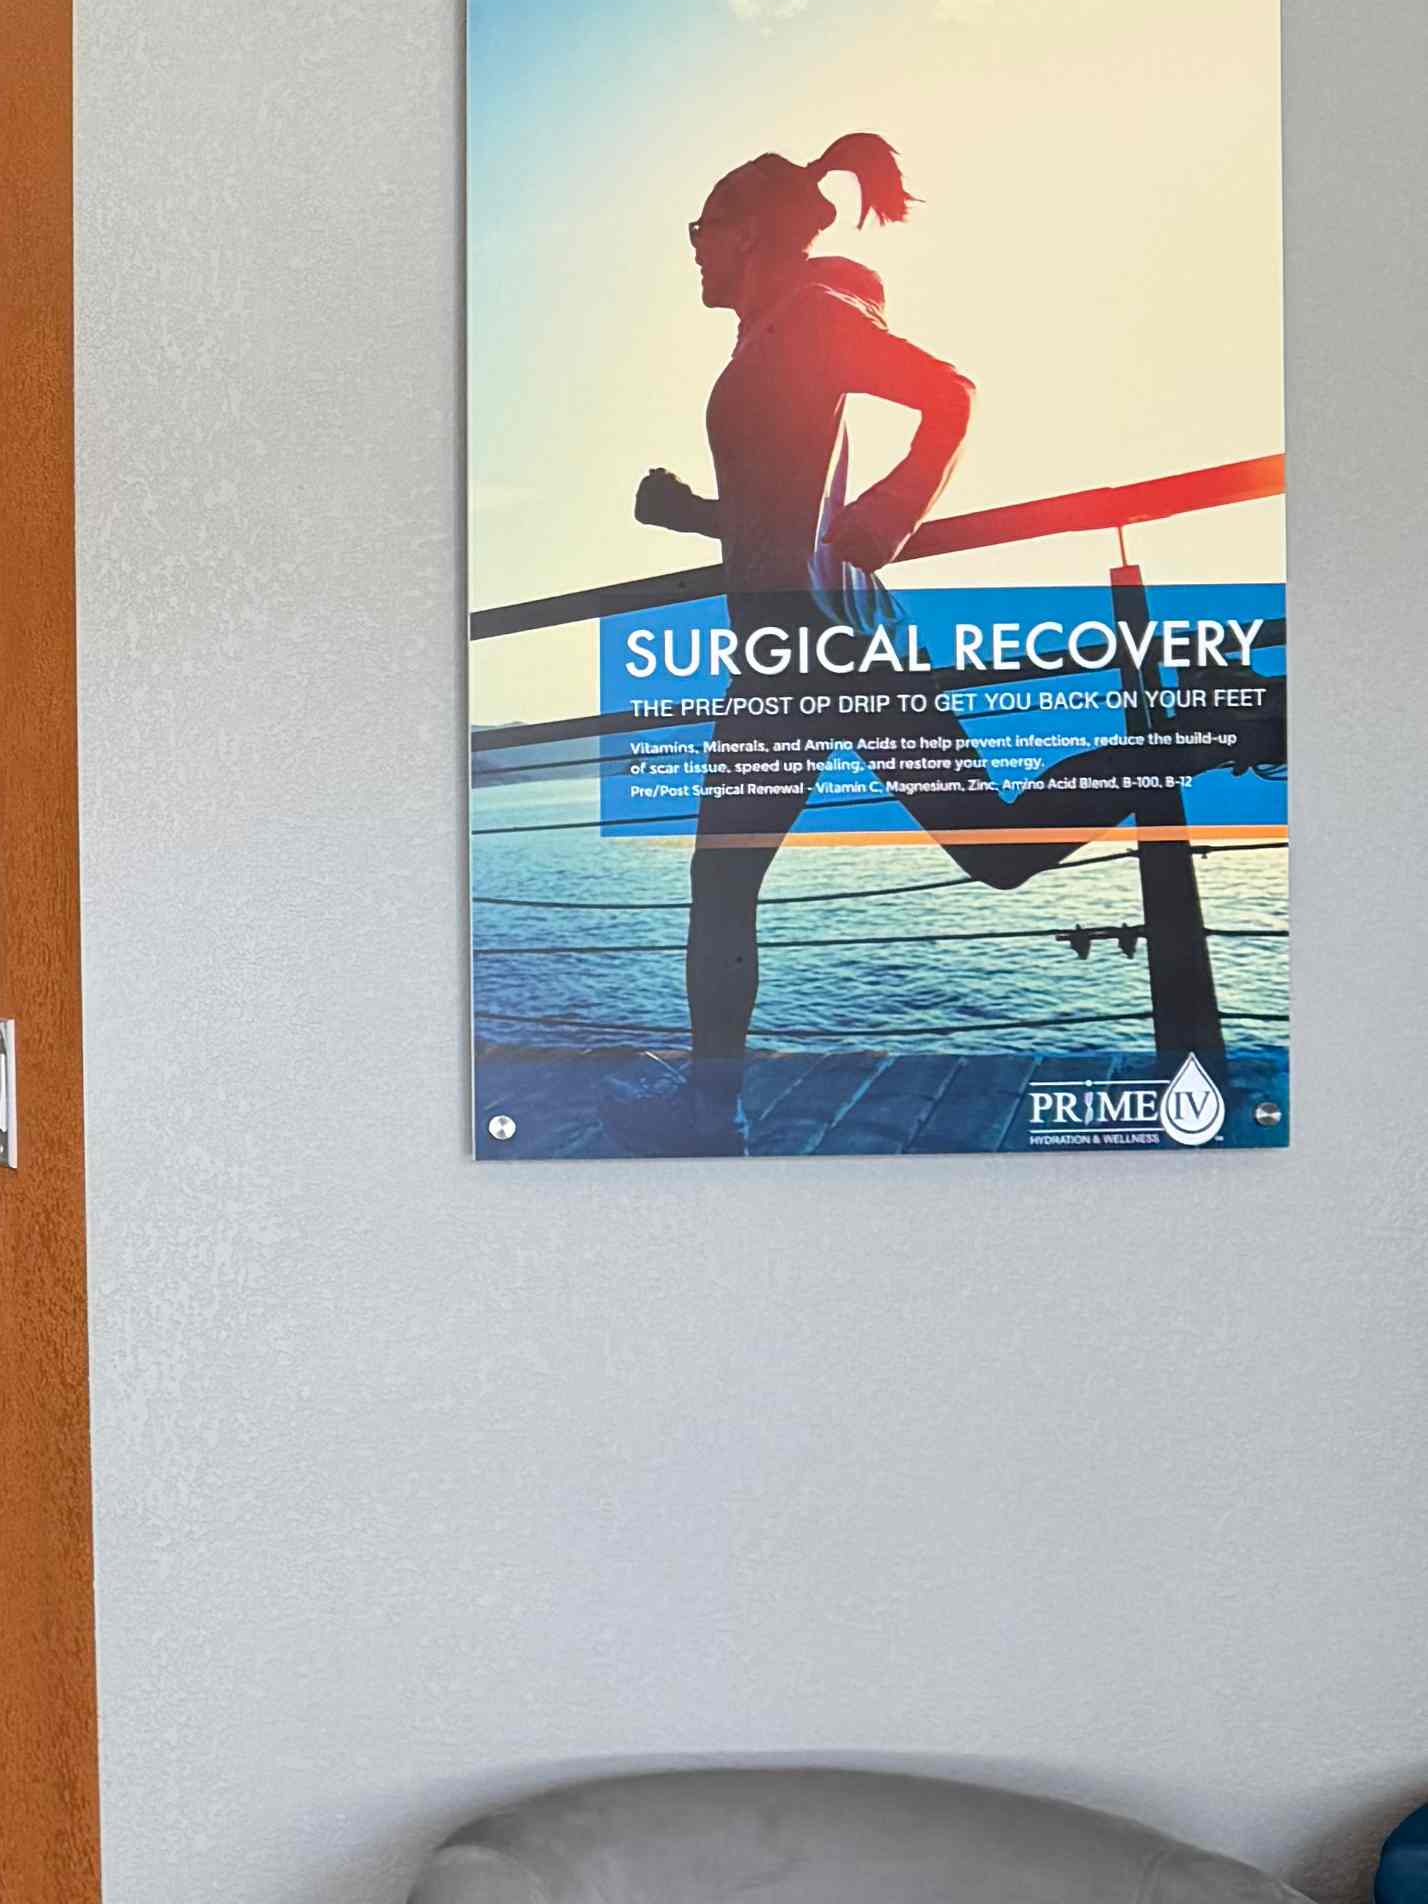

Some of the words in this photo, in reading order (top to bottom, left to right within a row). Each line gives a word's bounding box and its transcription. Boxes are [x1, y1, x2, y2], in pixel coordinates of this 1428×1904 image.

[625, 624, 931, 678] SURGICAL
[955, 619, 1264, 671] RECOVERY
[631, 700, 673, 717] THE
[681, 696, 792, 716] PRE/POST
[800, 696, 831, 714] OP
[839, 695, 890, 714] DRIP
[898, 694, 927, 712] TO
[935, 693, 977, 712] GET
[984, 692, 1031, 710] YOU
[1040, 691, 1099, 709] BACK
[1106, 691, 1137, 709] ON
[1145, 690, 1206, 708] YOUR
[1214, 688, 1266, 707] FEET
[631, 741, 699, 755] Vitamins,
[703, 739, 769, 753] Minerals,
[773, 739, 801, 751] and
[804, 738, 853, 751] Amino
[856, 737, 897, 750] Acids
[901, 738, 916, 749] to
[920, 735, 952, 751] help
[956, 735, 1012, 751] prevent
[1016, 733, 1092, 748] infections,
[1094, 733, 1144, 746] reduce
[1148, 733, 1172, 745] the
[1176, 732, 1237, 748] build-up
[631, 762, 645, 774] of
[650, 764, 679, 774] scar
[684, 761, 731, 775] tissue,
[735, 760, 779, 775] speed
[783, 762, 802, 774] up
[807, 758, 865, 773] healing,
[868, 758, 896, 770] and
[900, 758, 952, 770] restore
[956, 758, 987, 771] your
[991, 757, 1045, 771] energy.
[631, 785, 688, 798] Pre/Post
[692, 783, 744, 798] Surgical
[747, 782, 804, 795] Renewal
[815, 781, 866, 794] Vitamin
[869, 781, 882, 794] C,
[886, 779, 965, 795] Magnesium,
[968, 778, 998, 791] Zinc,
[1002, 777, 1045, 790] Amino
[1048, 776, 1077, 790] Acid
[1079, 776, 1119, 790] Blend,
[1122, 776, 1162, 789] B-100,
[1166, 776, 1192, 788] B-12
[1175, 1091, 1210, 1121] IV
[1030, 1135, 1091, 1145] HYDRATION
[1103, 1134, 1160, 1144] WELLNESS
